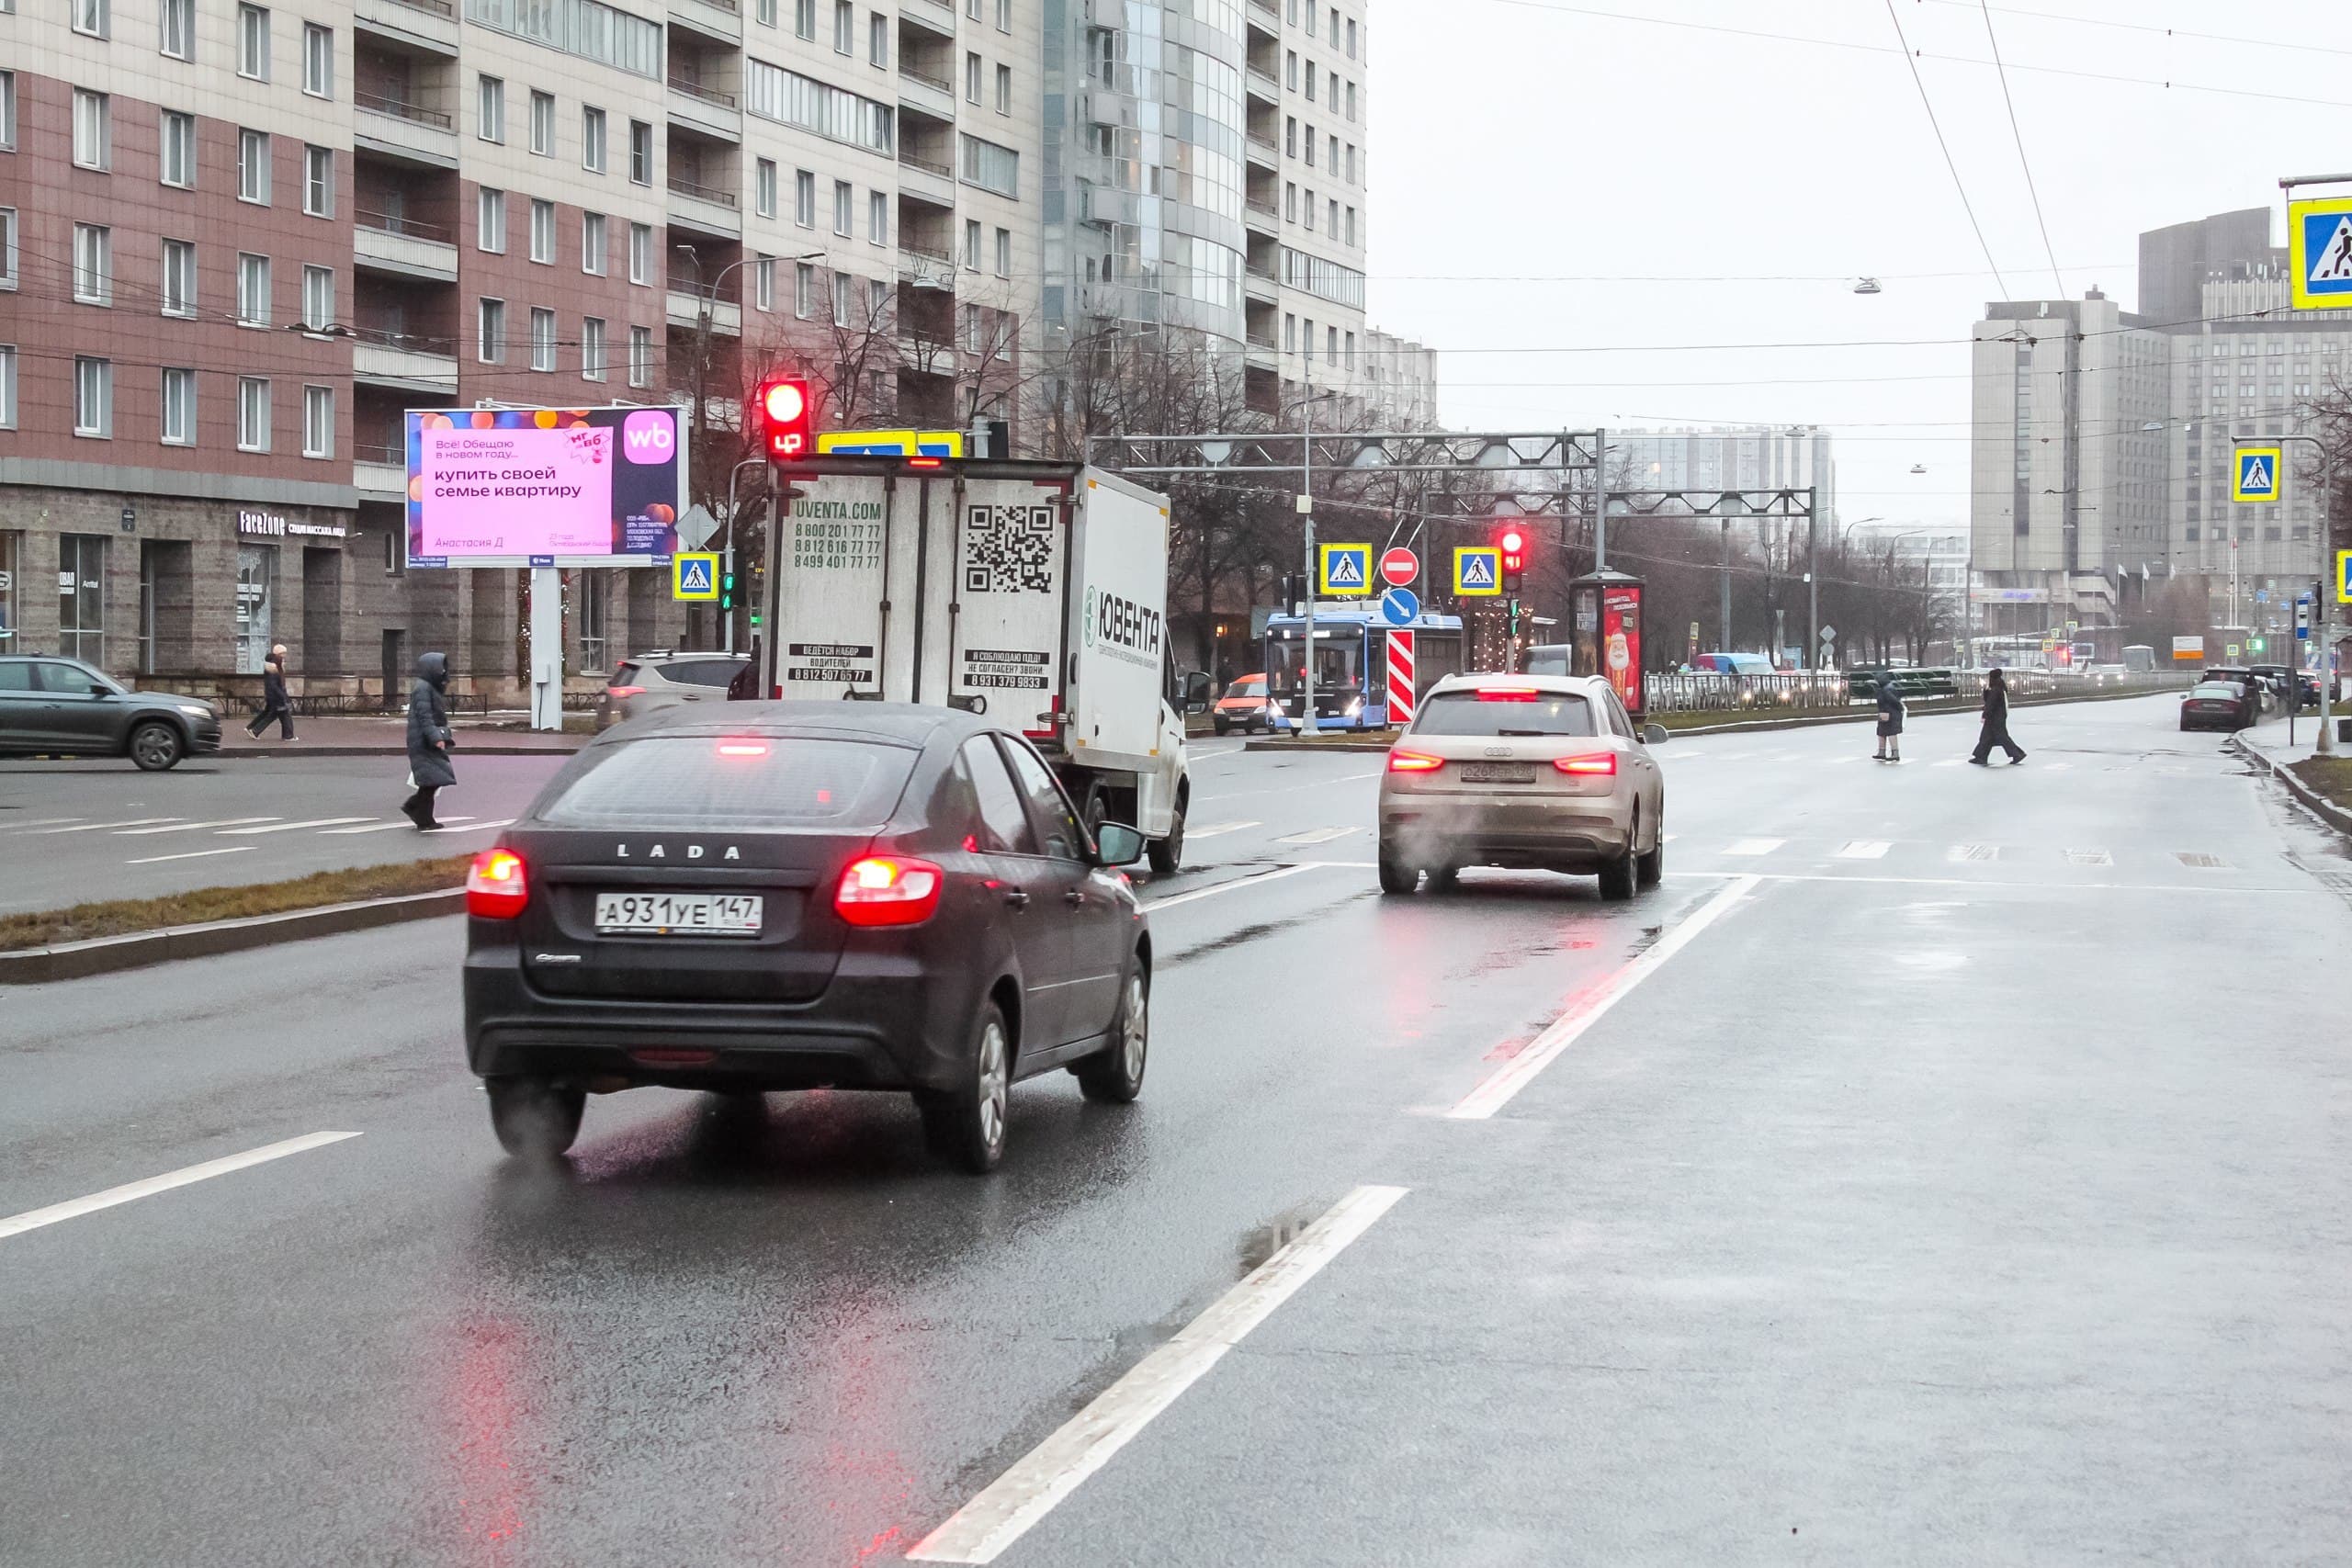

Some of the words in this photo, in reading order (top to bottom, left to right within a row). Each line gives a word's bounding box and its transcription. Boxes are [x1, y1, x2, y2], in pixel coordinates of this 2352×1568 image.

[628, 422, 671, 448] wb
[462, 439, 514, 449] Обещаю
[446, 451, 482, 459] новом
[435, 469, 498, 483] купить
[501, 466, 556, 480] своей
[435, 487, 490, 497] семье
[494, 486, 582, 499] квартиру
[796, 501, 882, 520] UVENTA.COM
[240, 511, 285, 536] FaceZone
[796, 524, 802, 536] 8
[805, 524, 825, 537] 800
[828, 525, 847, 537] 201
[852, 525, 864, 538] 77
[867, 525, 880, 538] 77
[435, 537, 492, 547] Анастасия
[494, 536, 503, 547] Д
[795, 539, 801, 552] 8
[805, 539, 824, 553] 812
[827, 540, 847, 553] 616
[851, 540, 864, 554] 77
[867, 540, 880, 554] 77
[795, 555, 801, 568] 8
[803, 555, 823, 568] 499
[826, 556, 846, 569] 401
[850, 556, 863, 569] 77
[867, 556, 880, 569] 77
[1098, 592, 1159, 655] ЮВЕНТА
[835, 647, 859, 656] НАБОР
[978, 652, 1021, 662] СОБЛЮДАЮ
[809, 658, 851, 668] ВОДИТЕЛЕЙ
[968, 664, 977, 672] НЕ
[978, 664, 1018, 673] СОГЛАСЕН?
[795, 669, 801, 680] 8
[803, 669, 820, 680] 812
[821, 670, 838, 681] 507
[854, 671, 865, 682] 77
[971, 675, 978, 686] 8
[979, 675, 996, 686] 931
[998, 676, 1016, 687] 379
[616, 844, 740, 860] LADA
[715, 897, 754, 918] 147
